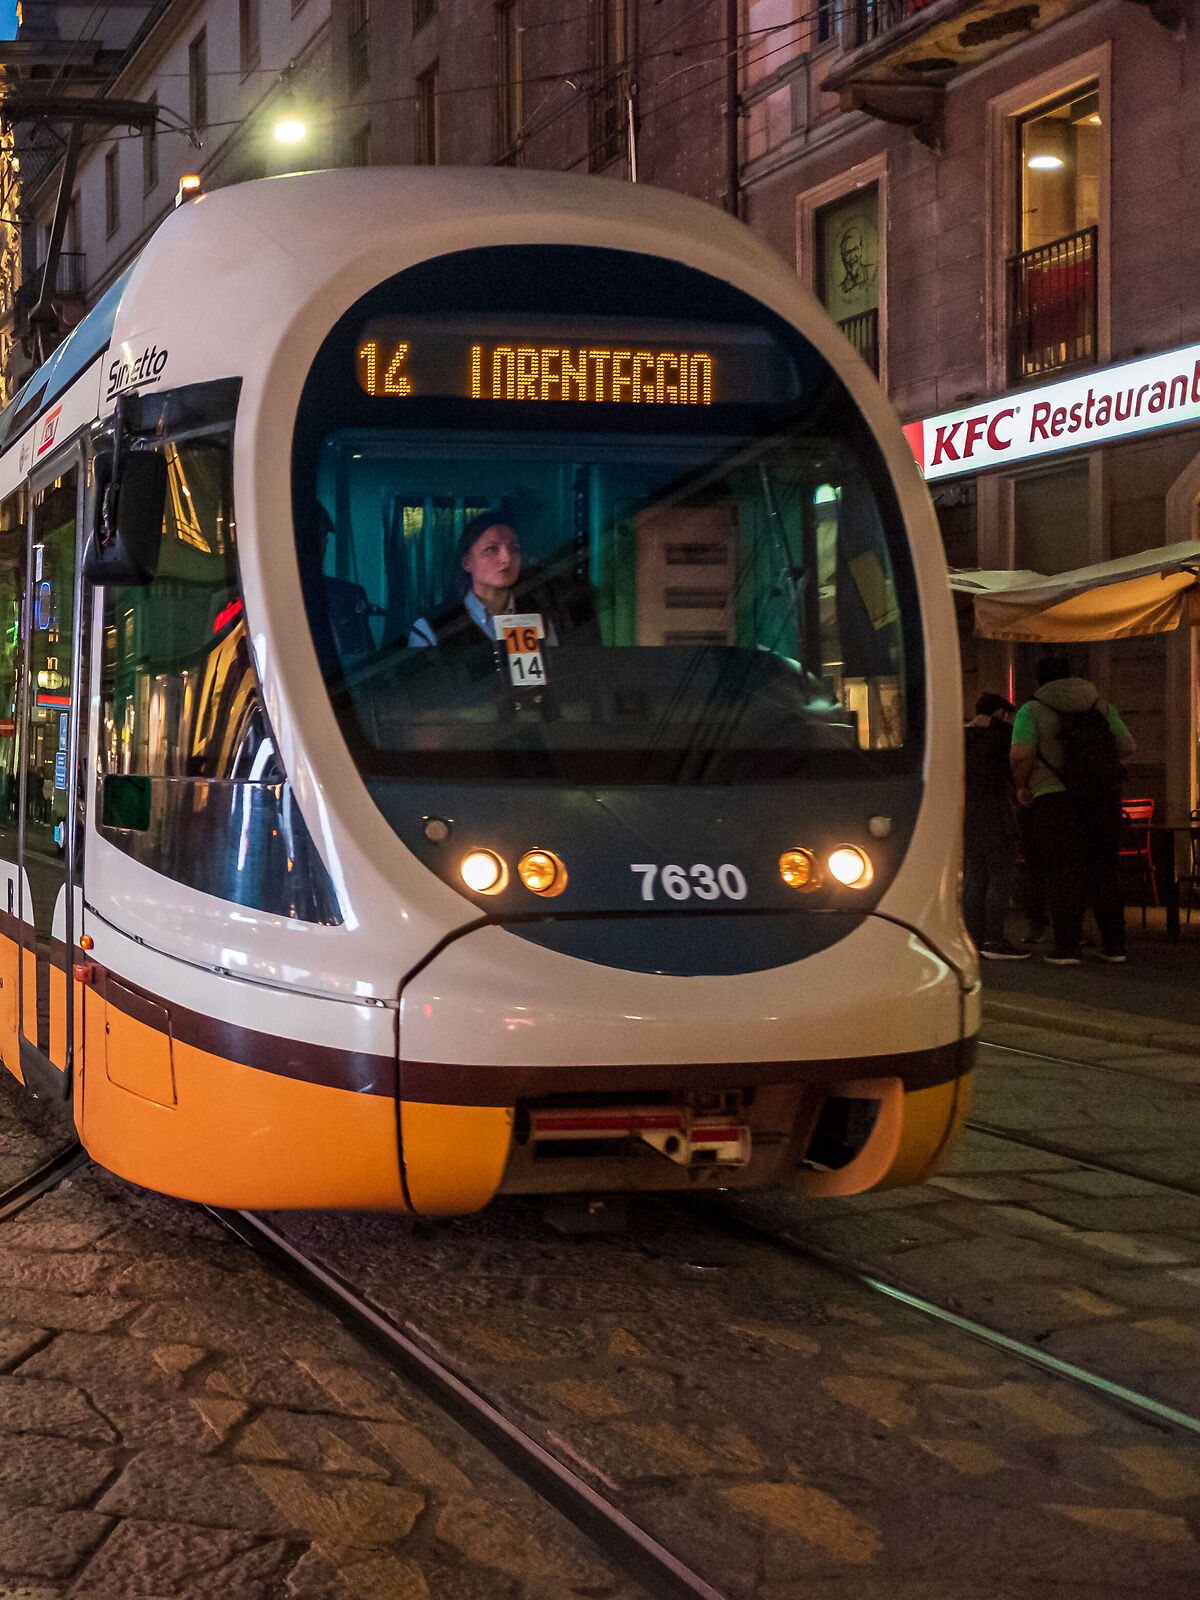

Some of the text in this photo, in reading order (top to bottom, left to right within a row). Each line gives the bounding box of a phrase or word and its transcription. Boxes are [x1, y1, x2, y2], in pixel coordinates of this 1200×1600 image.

[360, 343, 411, 396] 14
[931, 408, 1014, 466] KFC
[508, 628, 536, 651] 16
[513, 656, 543, 679] 14
[630, 863, 748, 900] 7630
